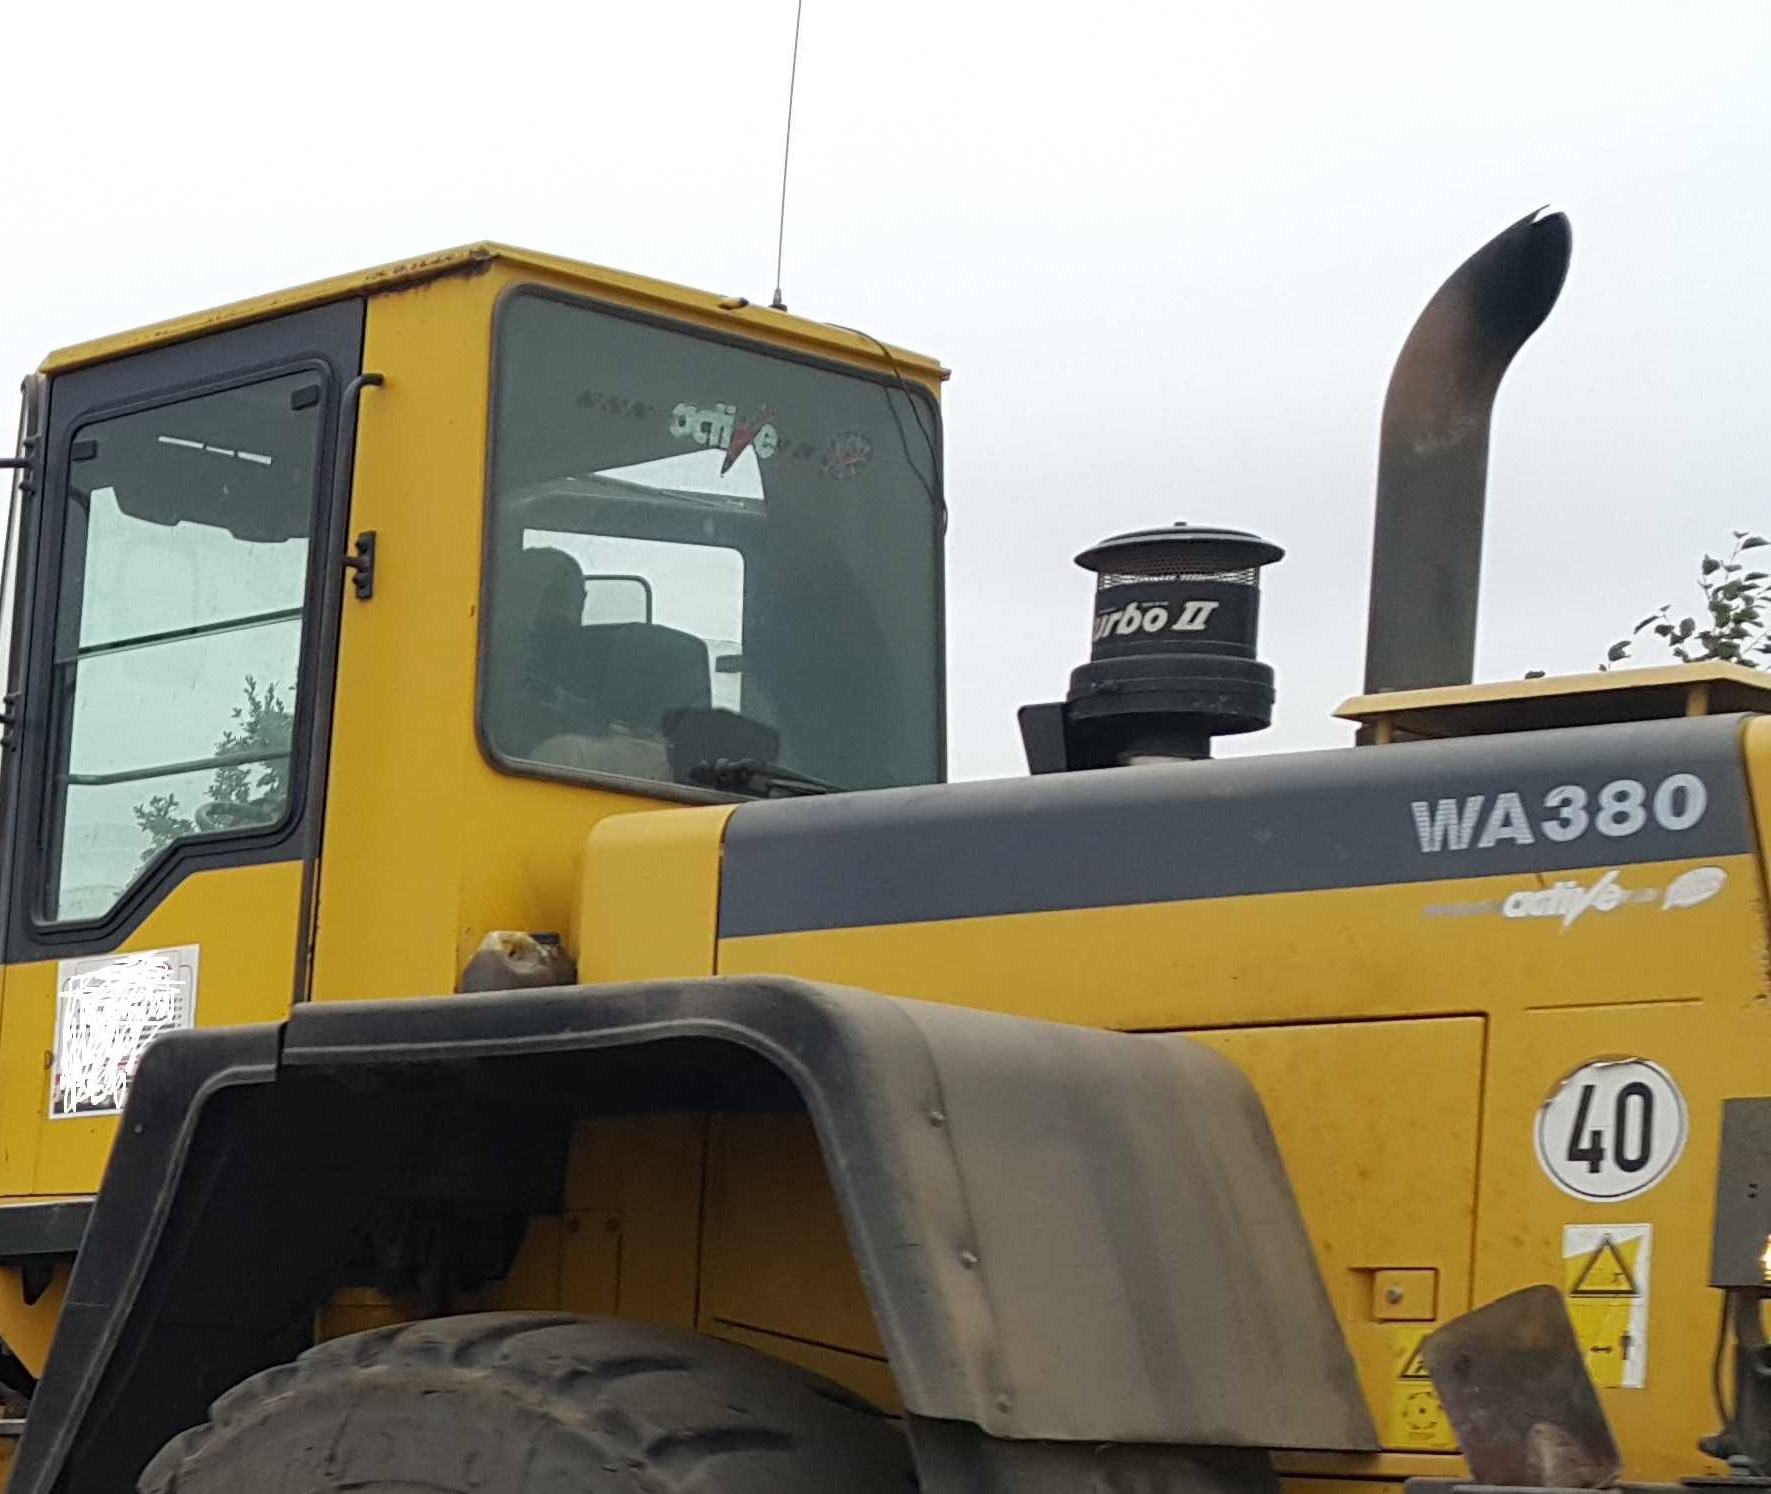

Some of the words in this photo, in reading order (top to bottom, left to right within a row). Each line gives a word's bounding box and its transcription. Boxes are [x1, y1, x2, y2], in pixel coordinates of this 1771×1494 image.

[1093, 601, 1169, 641] urbo
[1171, 600, 1220, 631] II
[1411, 773, 1708, 853] WA380
[1567, 1081, 1653, 1173] 40
